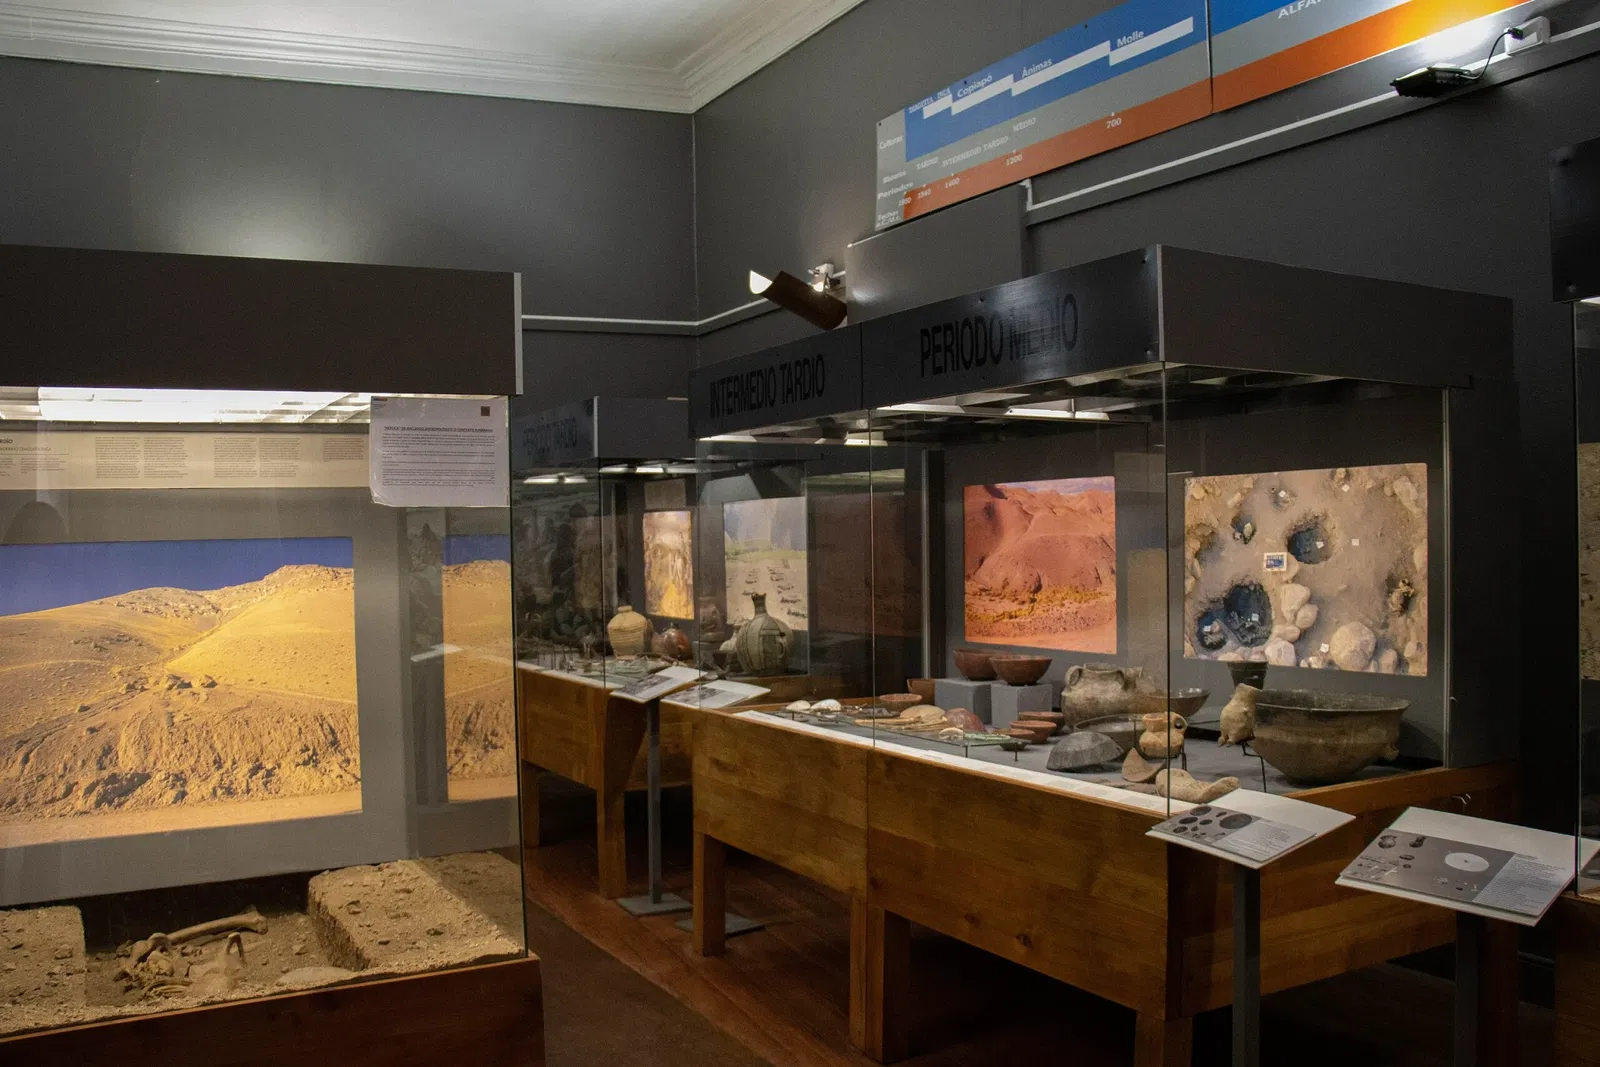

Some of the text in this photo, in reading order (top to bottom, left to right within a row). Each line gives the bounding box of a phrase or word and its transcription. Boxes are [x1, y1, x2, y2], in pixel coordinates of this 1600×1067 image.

[1277, 0, 1321, 19] ALFA
[1117, 30, 1145, 48] Molle
[1022, 58, 1053, 78] Ánimas
[957, 73, 993, 98] Copiapó
[1013, 117, 1037, 132] MEDIO
[1006, 153, 1023, 166] 1200
[1106, 117, 1122, 129] 700
[920, 293, 1079, 379] PERIODO MEDIO
[709, 353, 826, 420] INTERMEDIO TARDIO
